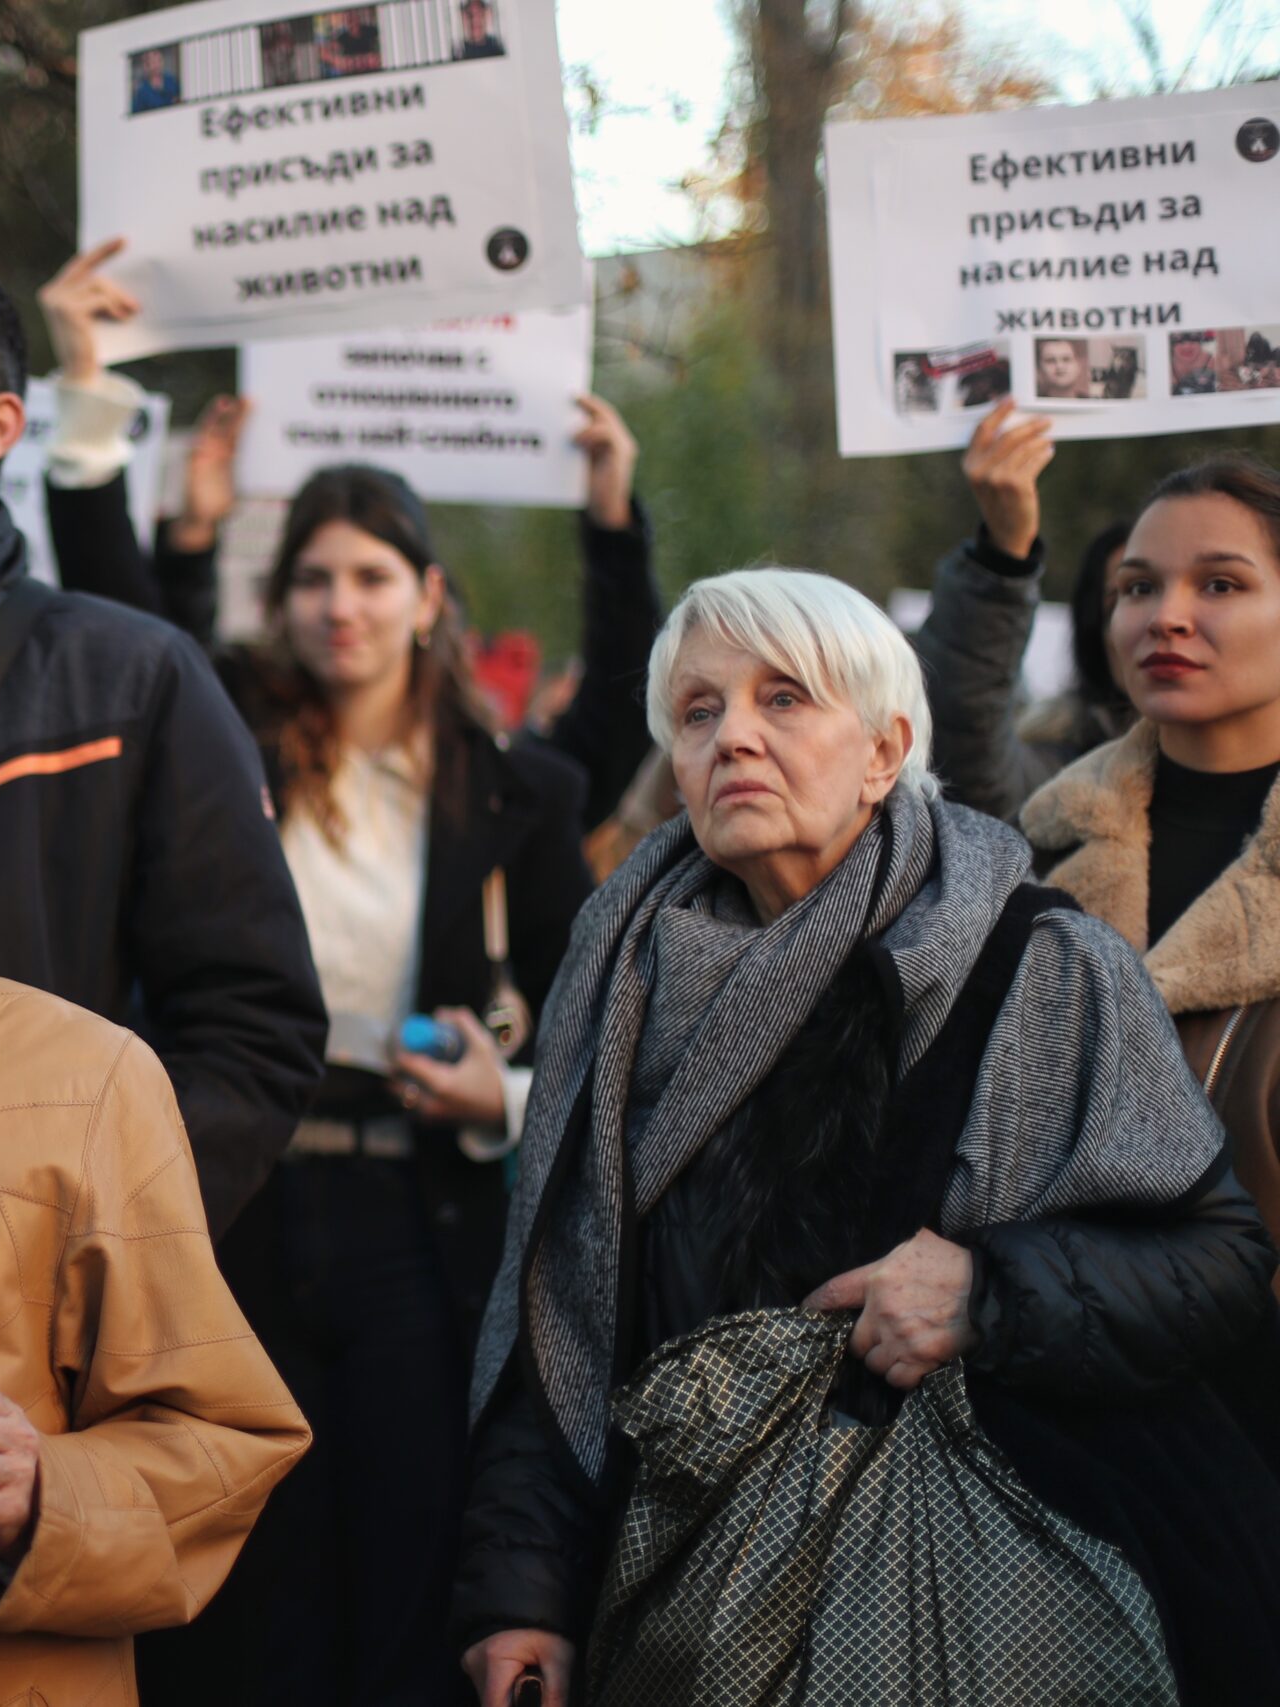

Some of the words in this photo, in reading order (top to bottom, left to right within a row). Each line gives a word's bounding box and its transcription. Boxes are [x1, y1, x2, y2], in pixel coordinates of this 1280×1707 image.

[199, 83, 426, 141] Ефективни
[200, 152, 379, 199] присъди
[391, 139, 435, 169] за
[969, 140, 1197, 189] Ефективни
[192, 204, 367, 251] насилие
[377, 194, 457, 228] над
[968, 199, 1148, 242] присъди
[1158, 193, 1203, 221] за
[236, 256, 424, 302] животни
[958, 253, 1132, 289] насилие
[1143, 246, 1221, 278] над
[995, 301, 1184, 336] животни
